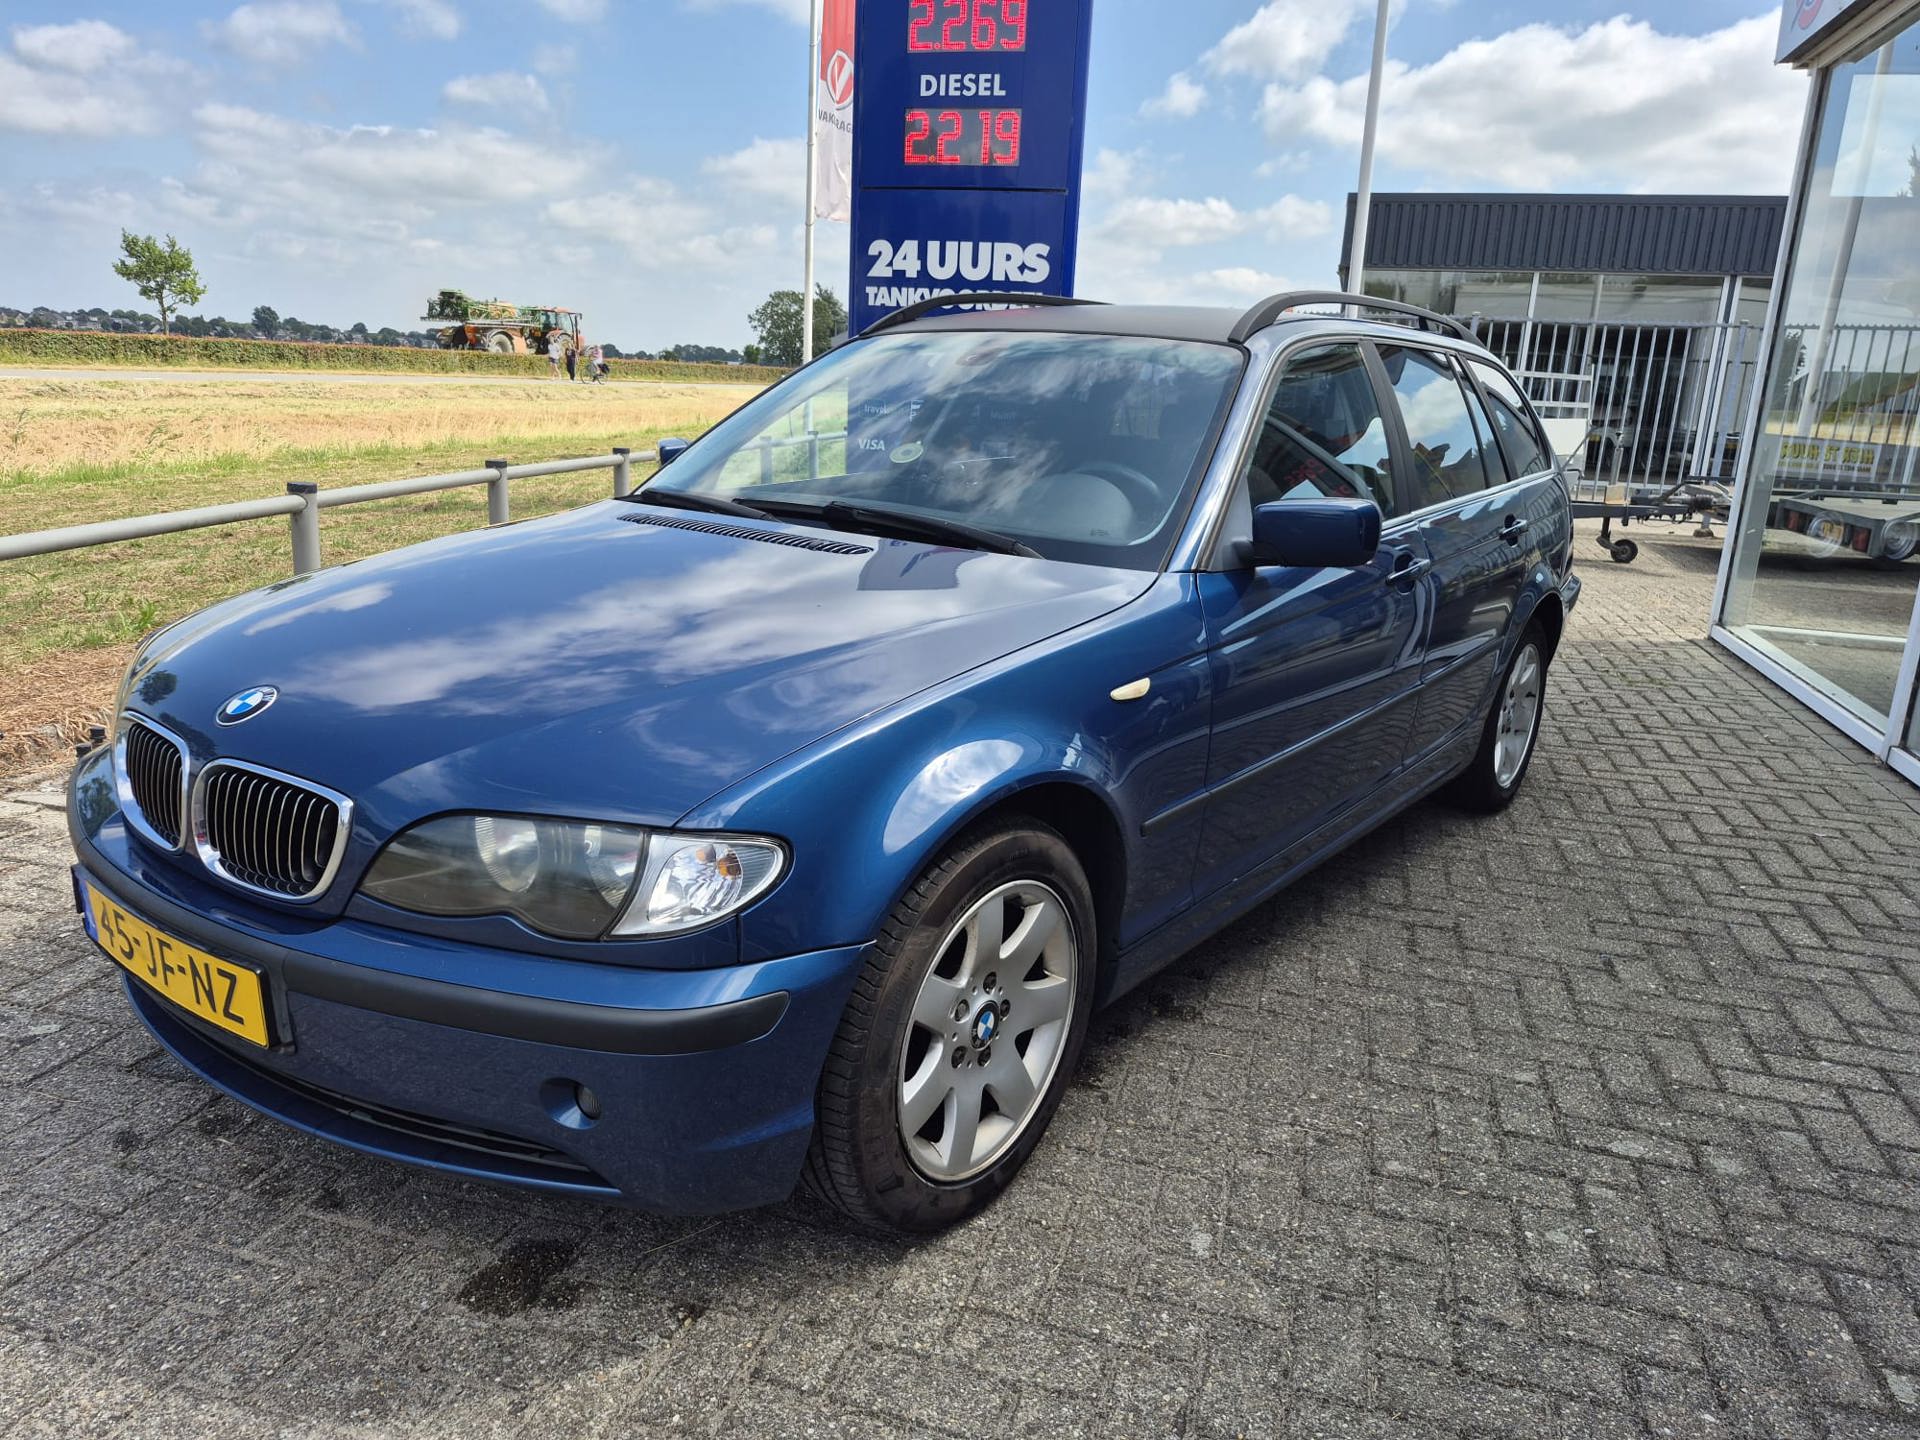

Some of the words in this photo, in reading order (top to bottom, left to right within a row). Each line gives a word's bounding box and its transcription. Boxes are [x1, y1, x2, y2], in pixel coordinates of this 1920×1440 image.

[909, 0, 1027, 51] 2.269
[920, 73, 1007, 97] DIESEL
[904, 111, 1020, 165] 2.219
[866, 239, 922, 278] 24
[926, 240, 1051, 284] UURS
[858, 437, 886, 452] VISA
[101, 901, 245, 1025] 45-JF-NZ
